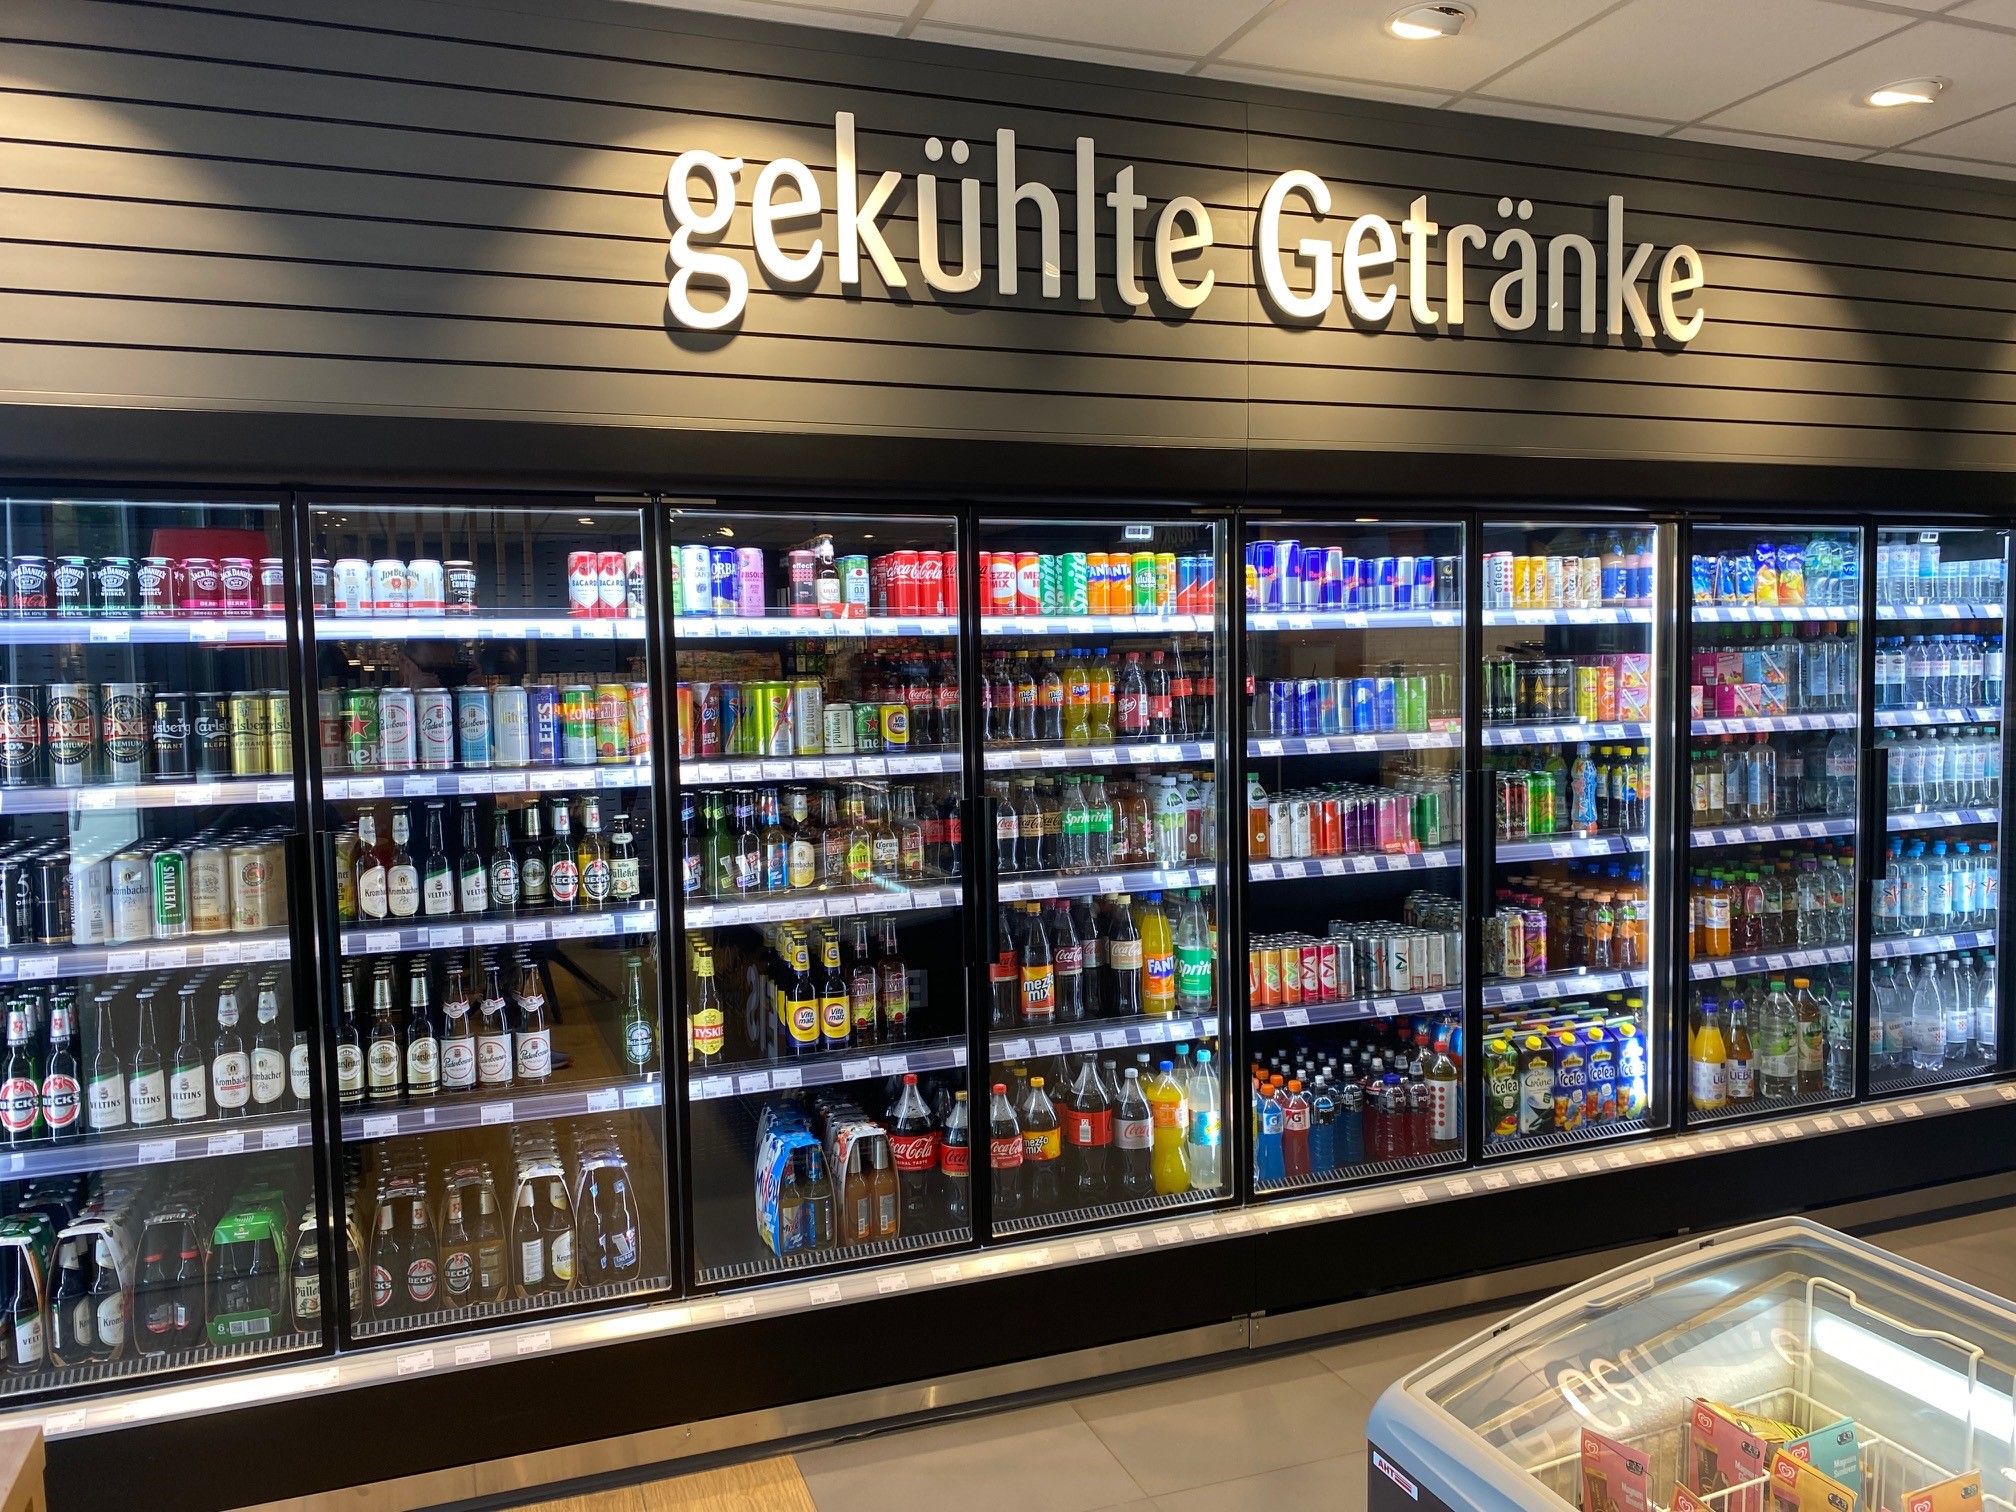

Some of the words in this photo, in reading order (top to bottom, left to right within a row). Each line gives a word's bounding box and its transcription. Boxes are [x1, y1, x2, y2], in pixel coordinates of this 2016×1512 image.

[667, 111, 1215, 329] gekühlte
[1259, 169, 1703, 342] Getränke
[629, 578, 644, 586] BACA
[1494, 561, 1503, 593] effect
[572, 579, 598, 587] BACARD
[600, 579, 625, 587] BACARD
[1070, 552, 1089, 614] Sprite
[0, 723, 37, 738] AXE
[48, 722, 91, 738] FAXE
[103, 721, 148, 736] FAXE
[153, 718, 191, 736] rlsberg
[52, 740, 84, 749] PREMIUM
[109, 740, 141, 748] PREMIUM
[875, 841, 898, 850] Corona
[847, 855, 867, 863] SALIT
[551, 876, 579, 885] BECK'S
[584, 876, 611, 885] BECK'S
[163, 865, 177, 910] VELTINS
[427, 889, 452, 899] VELTINS
[1147, 957, 1174, 974] FANT
[1027, 984, 1052, 1003] mix
[830, 1006, 844, 1016] Vita
[798, 1016, 815, 1025] malz
[828, 1014, 845, 1022] malz
[694, 1027, 724, 1039] TYSKIE
[370, 1054, 399, 1067] Warsteiner
[411, 1052, 439, 1063] Warsteiner
[338, 1058, 361, 1069] arsteiner
[291, 1068, 310, 1077] Kromb
[42, 1093, 80, 1107] BECK'S
[132, 1095, 161, 1105] VELTINS
[172, 1090, 202, 1100] VELTINS
[0, 1096, 39, 1110] BECK'S
[90, 1099, 121, 1109] VELTINS
[1291, 1111, 1301, 1123] G
[1022, 1135, 1049, 1148] mezzo
[1025, 1143, 1043, 1154] mix
[445, 1267, 473, 1278] BECK'S
[408, 1274, 437, 1285] BECK'S
[374, 1281, 392, 1290] CK'S
[217, 1323, 226, 1332] 6
[23, 1335, 41, 1346] VELT
[1378, 1458, 1395, 1478] AHT
